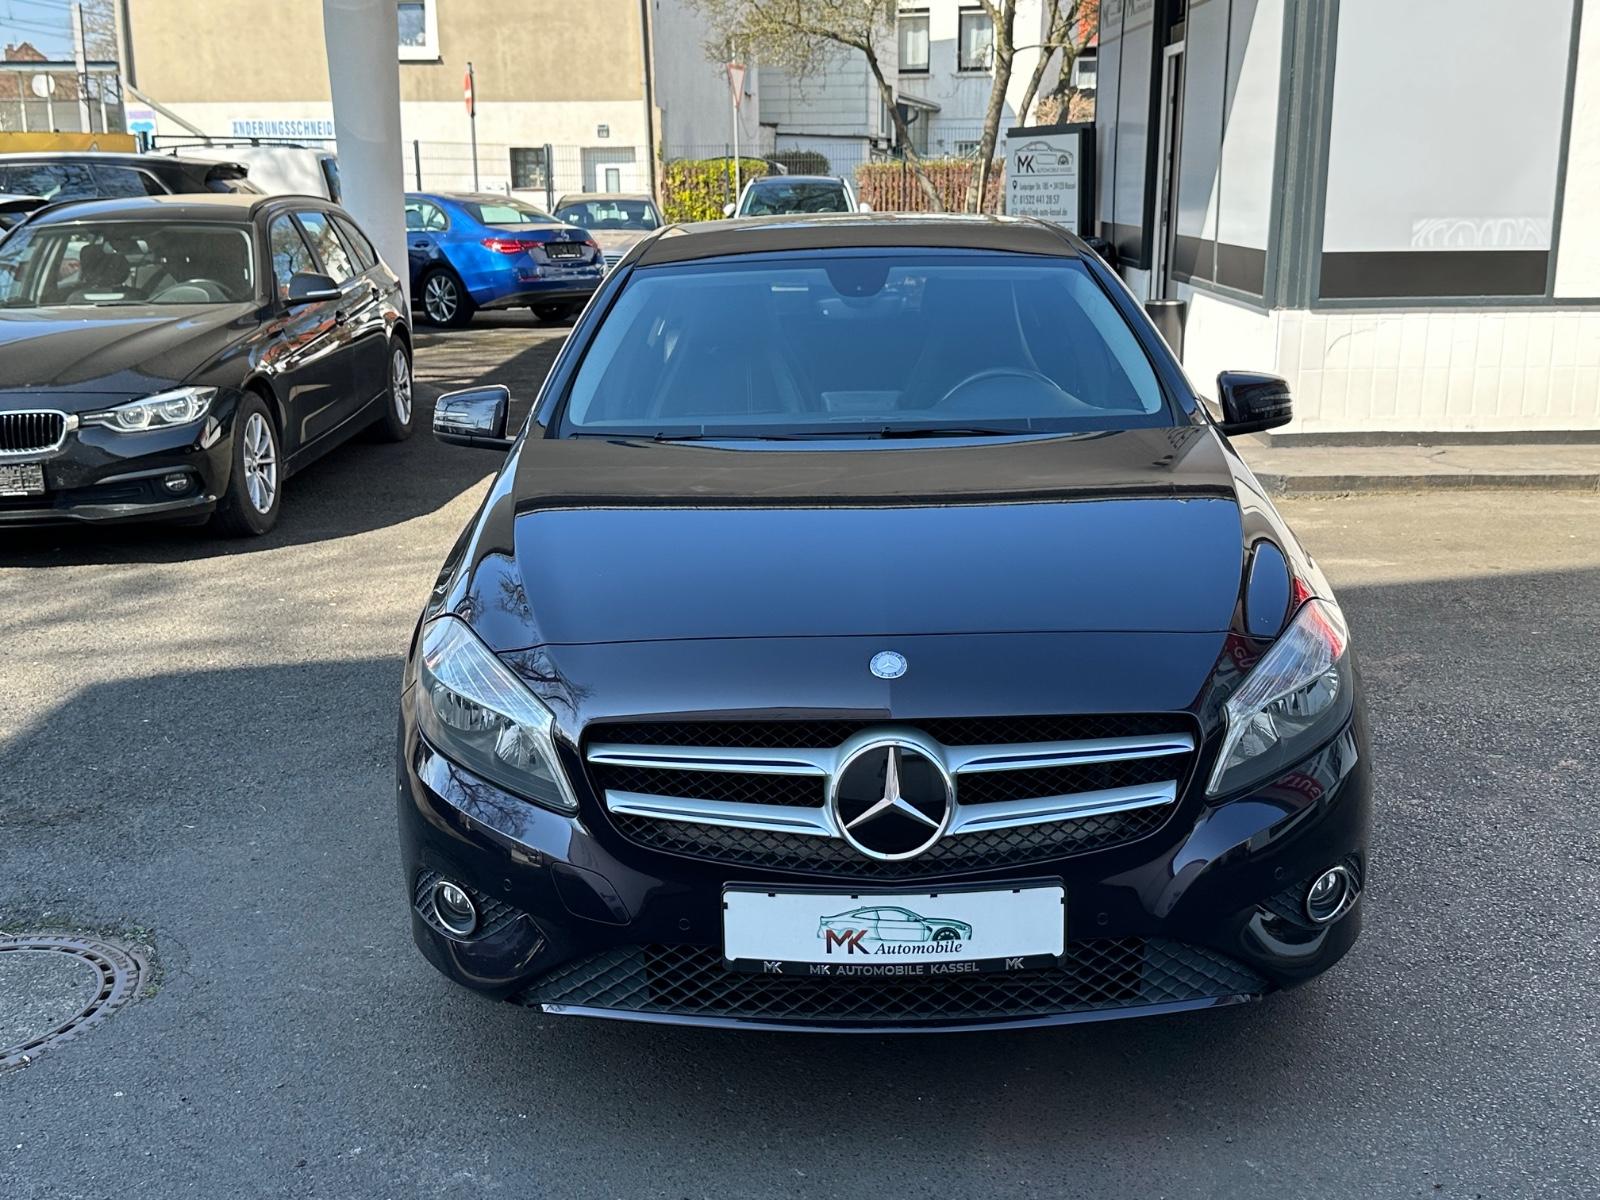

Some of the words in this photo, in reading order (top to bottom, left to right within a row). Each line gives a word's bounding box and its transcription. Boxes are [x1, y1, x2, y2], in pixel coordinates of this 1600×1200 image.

[1017, 155, 1035, 173] MK
[826, 929, 871, 954] MK
[874, 939, 963, 955] Automobile
[763, 961, 783, 974] MK
[809, 964, 831, 975] MK
[835, 964, 924, 976] AUTOMOBILE
[930, 961, 980, 974] KASSEL
[1005, 957, 1025, 970] MK
